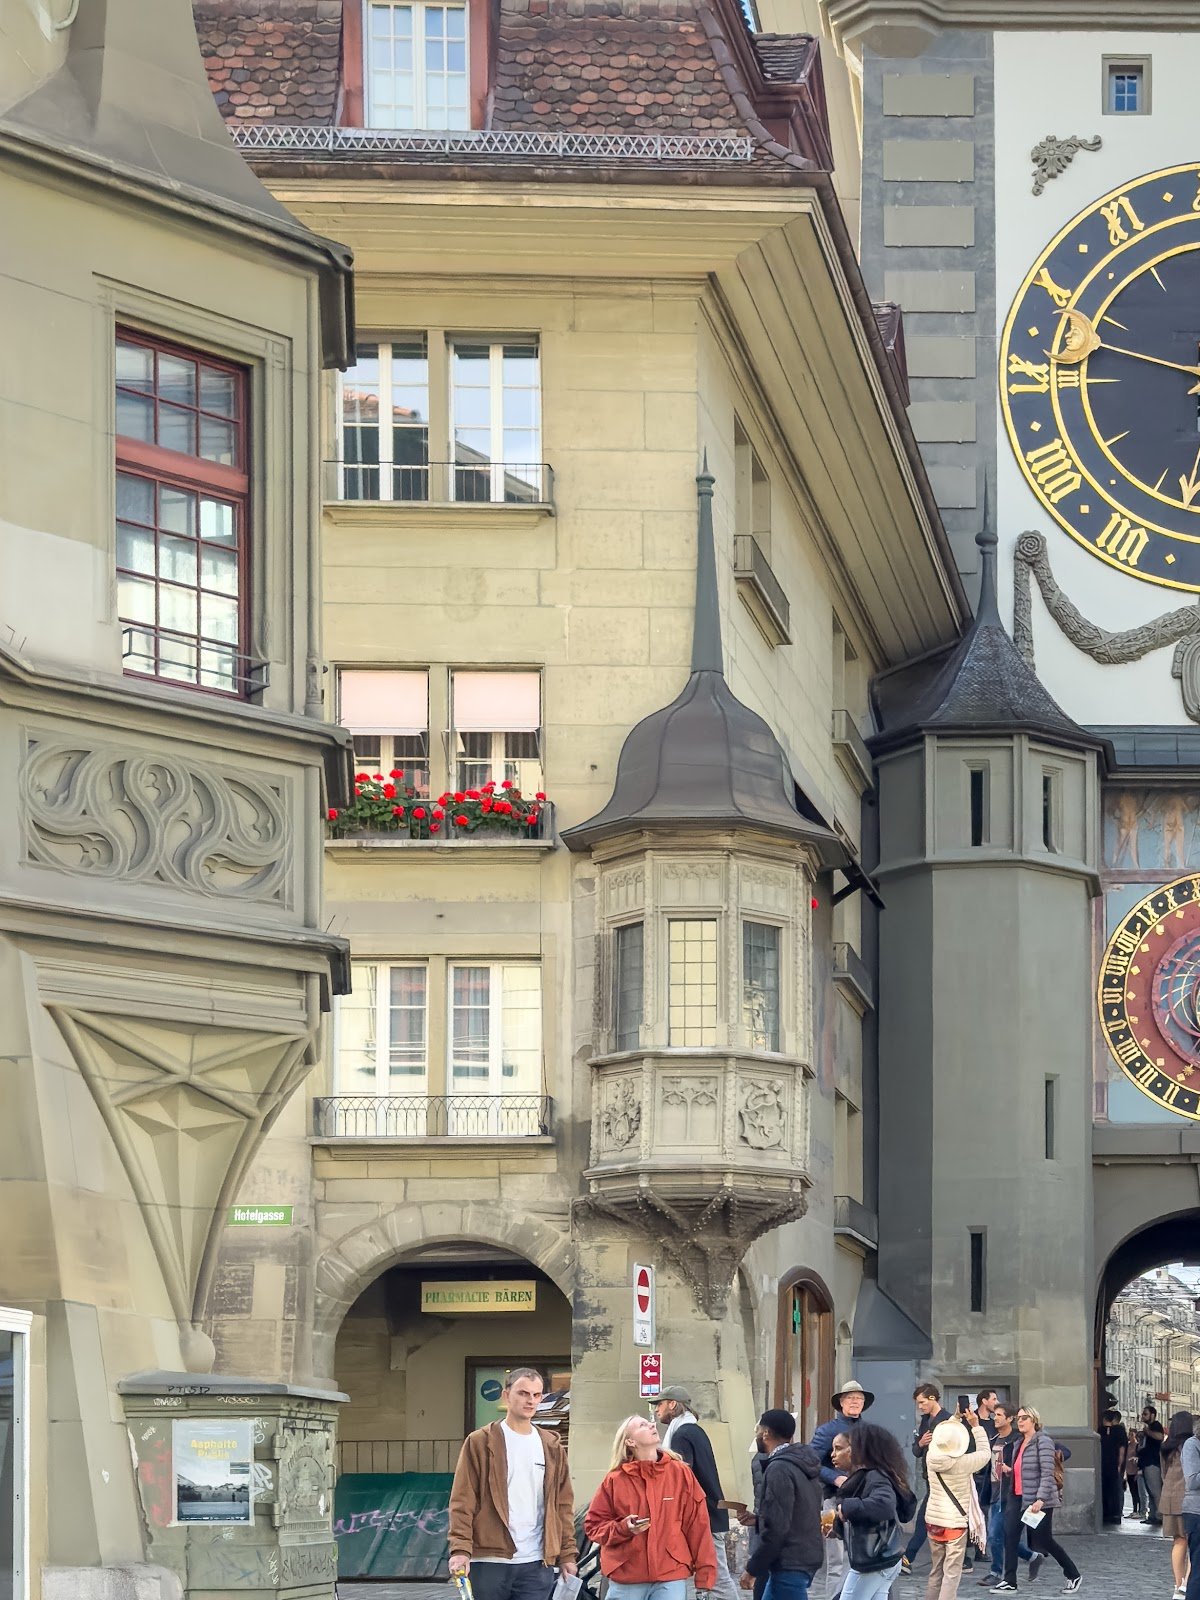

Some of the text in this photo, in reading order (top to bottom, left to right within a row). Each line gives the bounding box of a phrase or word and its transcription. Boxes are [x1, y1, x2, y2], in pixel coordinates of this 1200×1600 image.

[234, 1208, 284, 1224] Hotelgasse
[425, 1288, 532, 1304] PHARMACIE BÄREN
